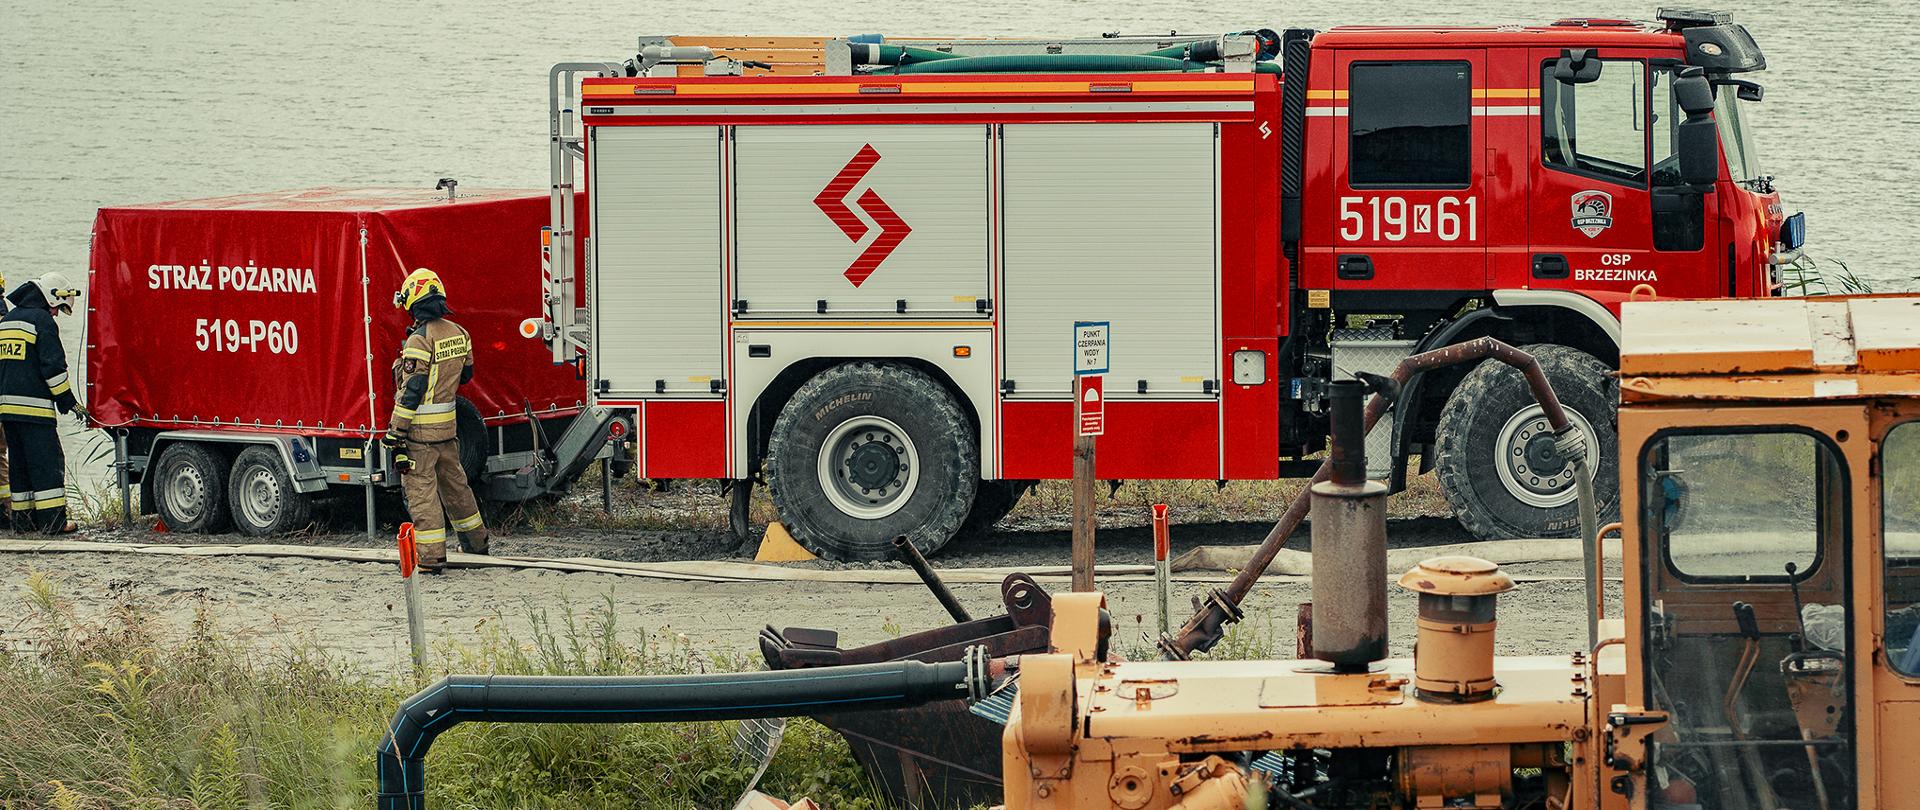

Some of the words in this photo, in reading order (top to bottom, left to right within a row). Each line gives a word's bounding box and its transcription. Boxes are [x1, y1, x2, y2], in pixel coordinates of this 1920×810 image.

[1341, 196, 1407, 241] 519
[1416, 207, 1428, 230] K
[1437, 196, 1477, 241] 61
[1601, 253, 1632, 266] OSP
[147, 259, 213, 291] STRAŻ
[218, 260, 318, 294] POŻARNA
[1574, 269, 1658, 282] BRZEZINKA
[195, 318, 298, 355] 519-P60
[1078, 339, 1106, 348] CZERPANIA
[1084, 330, 1100, 338] PUNKT
[815, 392, 872, 421] MICHELIN
